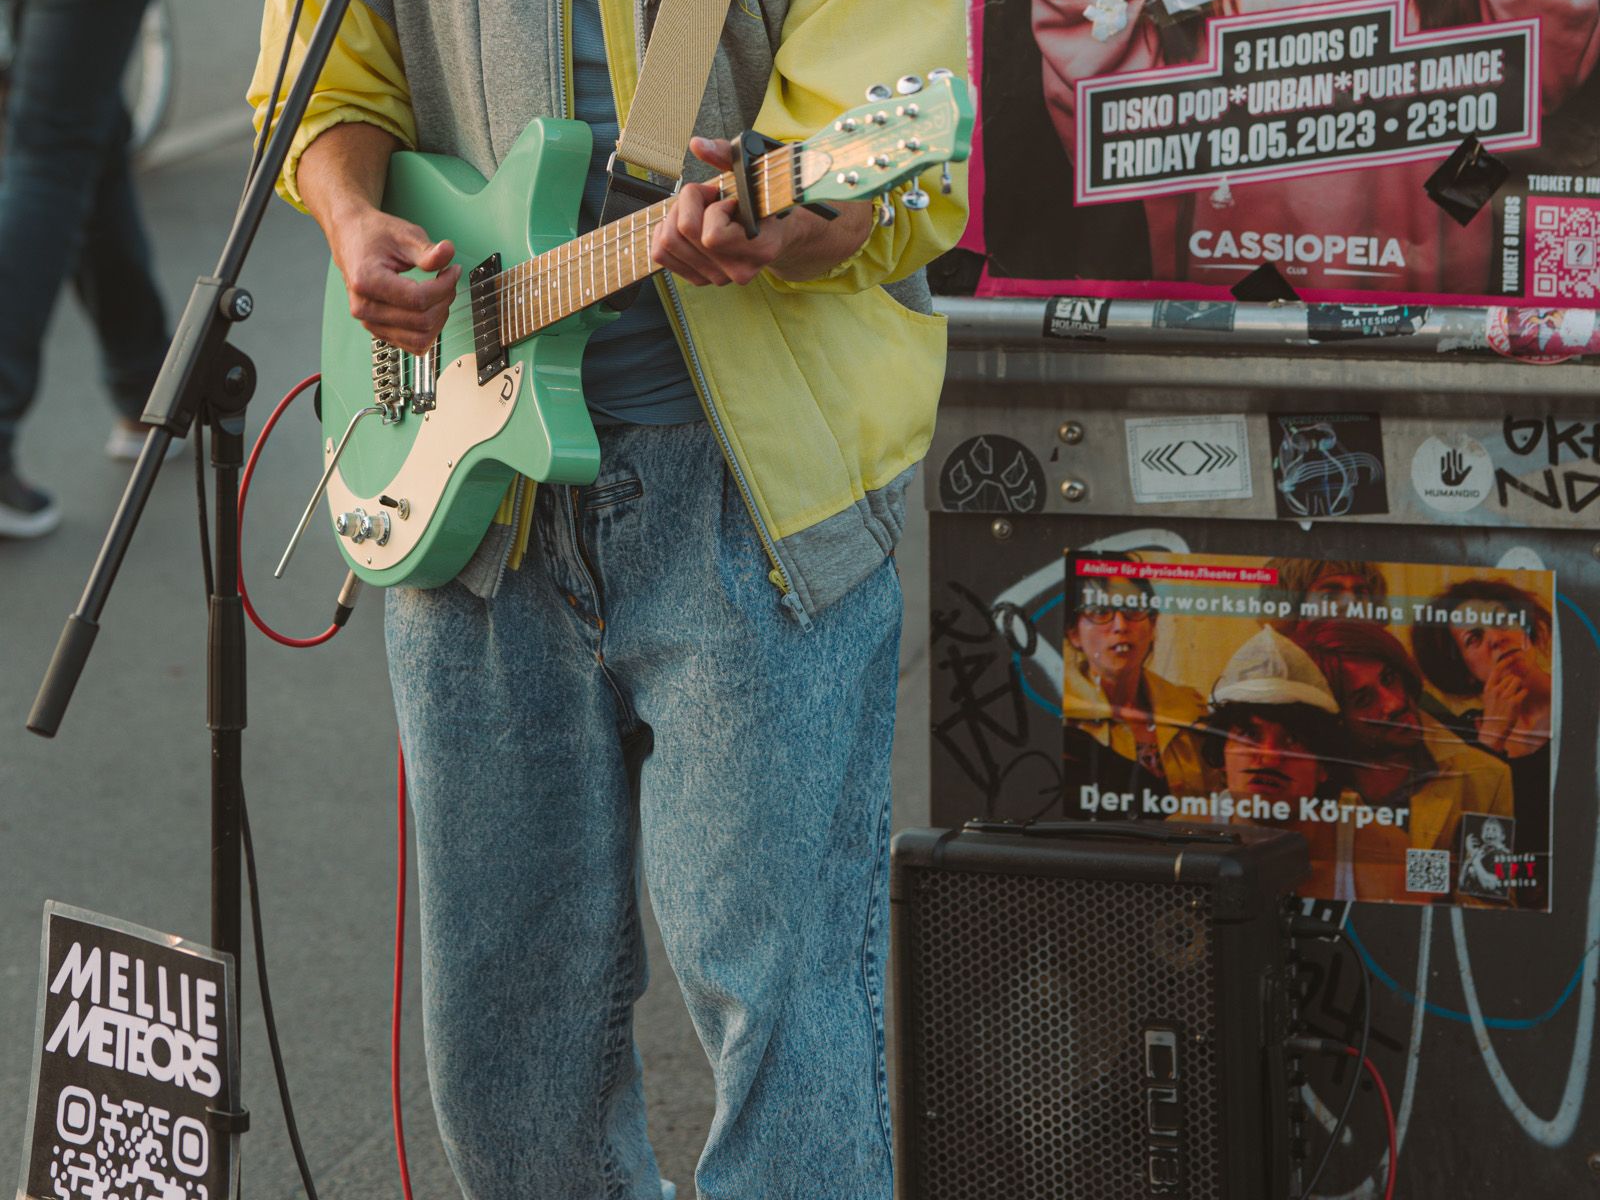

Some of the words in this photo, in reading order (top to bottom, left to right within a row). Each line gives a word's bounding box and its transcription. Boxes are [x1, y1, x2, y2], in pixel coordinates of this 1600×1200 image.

[1234, 41, 1251, 73] 3
[1256, 29, 1345, 71] FLOORS
[1350, 24, 1378, 59] OF
[1102, 94, 1174, 134] DISKO
[1420, 49, 1503, 92] DANCE
[1102, 132, 1202, 180] FRIDAY
[1207, 109, 1376, 167] 19.05.2023
[1407, 92, 1498, 141] 23:00
[1528, 175, 1573, 192] TICKET
[1503, 196, 1521, 235] INFOS
[1189, 230, 1405, 267] CASSIOPEIA
[1286, 266, 1308, 275] CLUB
[1503, 247, 1519, 292] TICKET
[1341, 315, 1401, 329] SKATESHOP
[1083, 563, 1119, 574] Atelier
[1121, 564, 1137, 575] für
[1240, 570, 1271, 581] Berlin
[1082, 589, 1291, 617] Theaterworkshop
[1300, 601, 1339, 617] mit
[1346, 602, 1403, 620] Mina
[1413, 604, 1527, 627] Tinaburri
[1079, 785, 1134, 812] Der
[1142, 788, 1290, 820] komische
[1300, 795, 1410, 829] Körper
[50, 942, 218, 1040] MELLIE
[45, 1000, 221, 1098] METEORS
